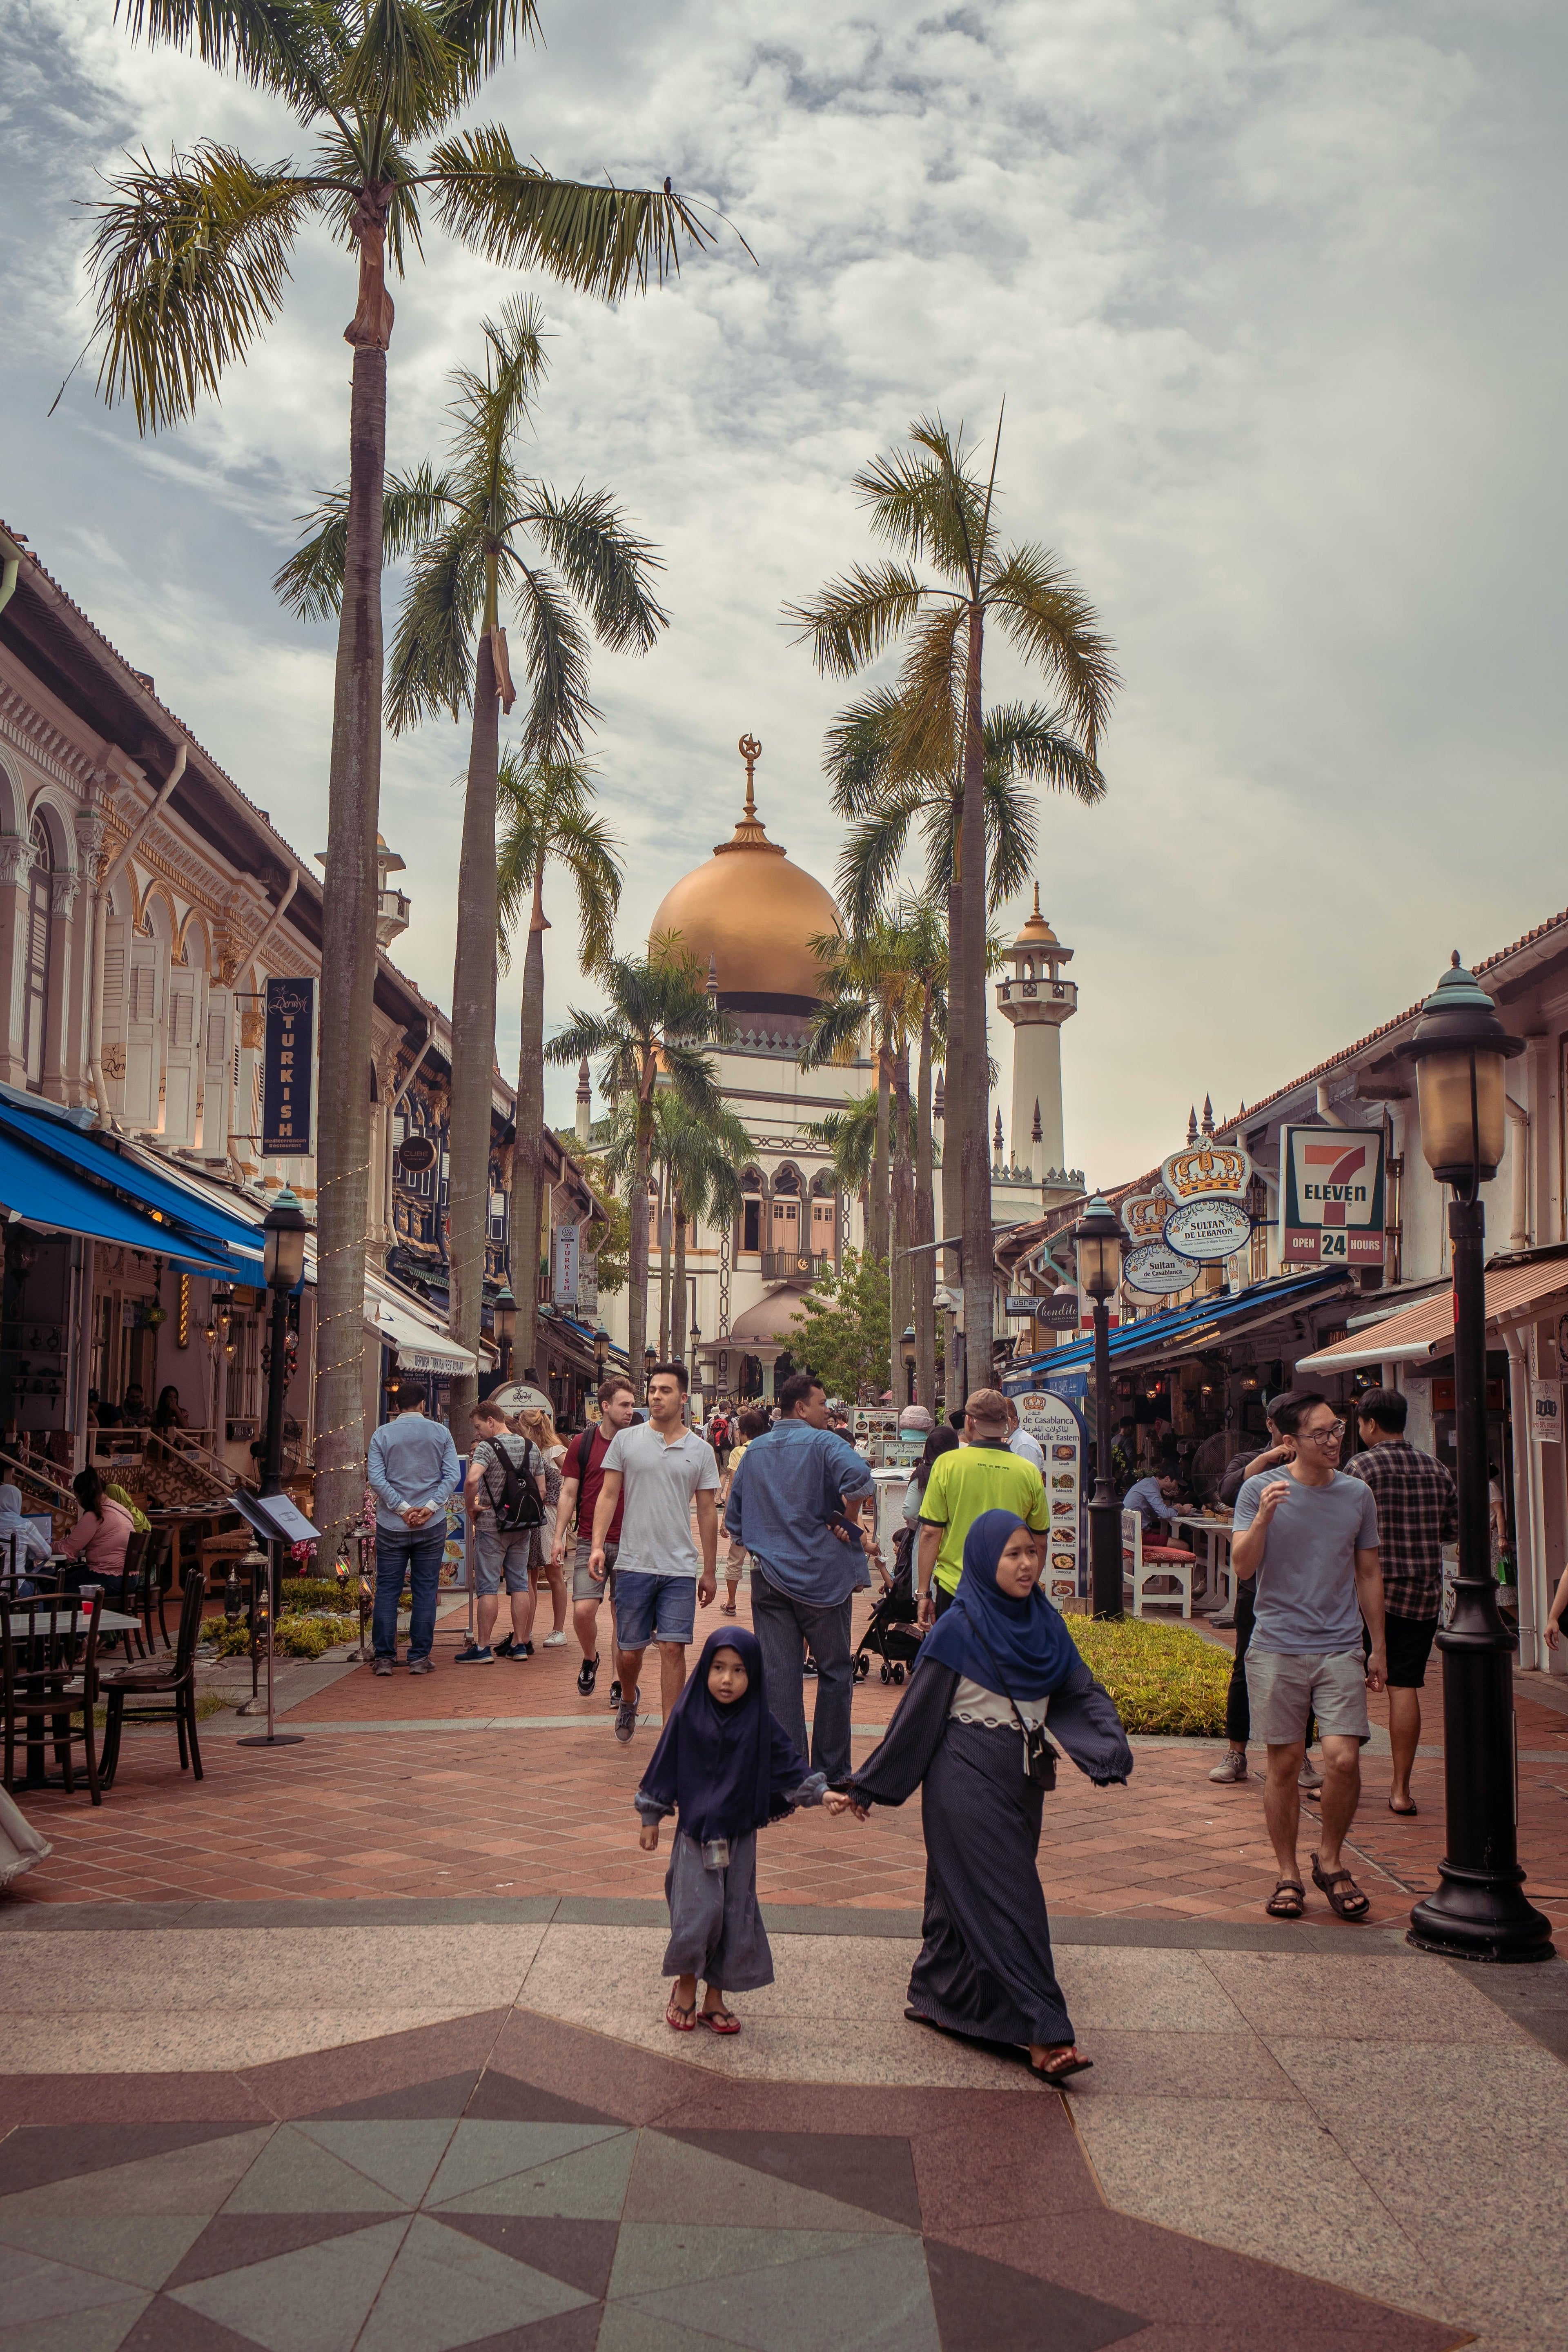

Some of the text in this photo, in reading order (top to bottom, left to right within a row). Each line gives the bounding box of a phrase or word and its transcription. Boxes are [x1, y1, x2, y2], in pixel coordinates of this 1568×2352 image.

[268, 993, 309, 1015] Derwish
[279, 1017, 294, 1136] TURKISH
[1190, 1220, 1225, 1231] SULTAN
[1197, 1228, 1233, 1236] LEBANON
[1292, 1234, 1380, 1256] OPEN 24 HOURS
[1149, 1261, 1175, 1270] Sultan
[1328, 1330, 1346, 1344] RABIAN
[415, 1354, 463, 1372] DERWISH TURKISH RESTAURANT
[513, 1392, 532, 1403] Derwish
[1537, 1402, 1555, 1414] SALE
[1035, 1416, 1074, 1424] Casablanca
